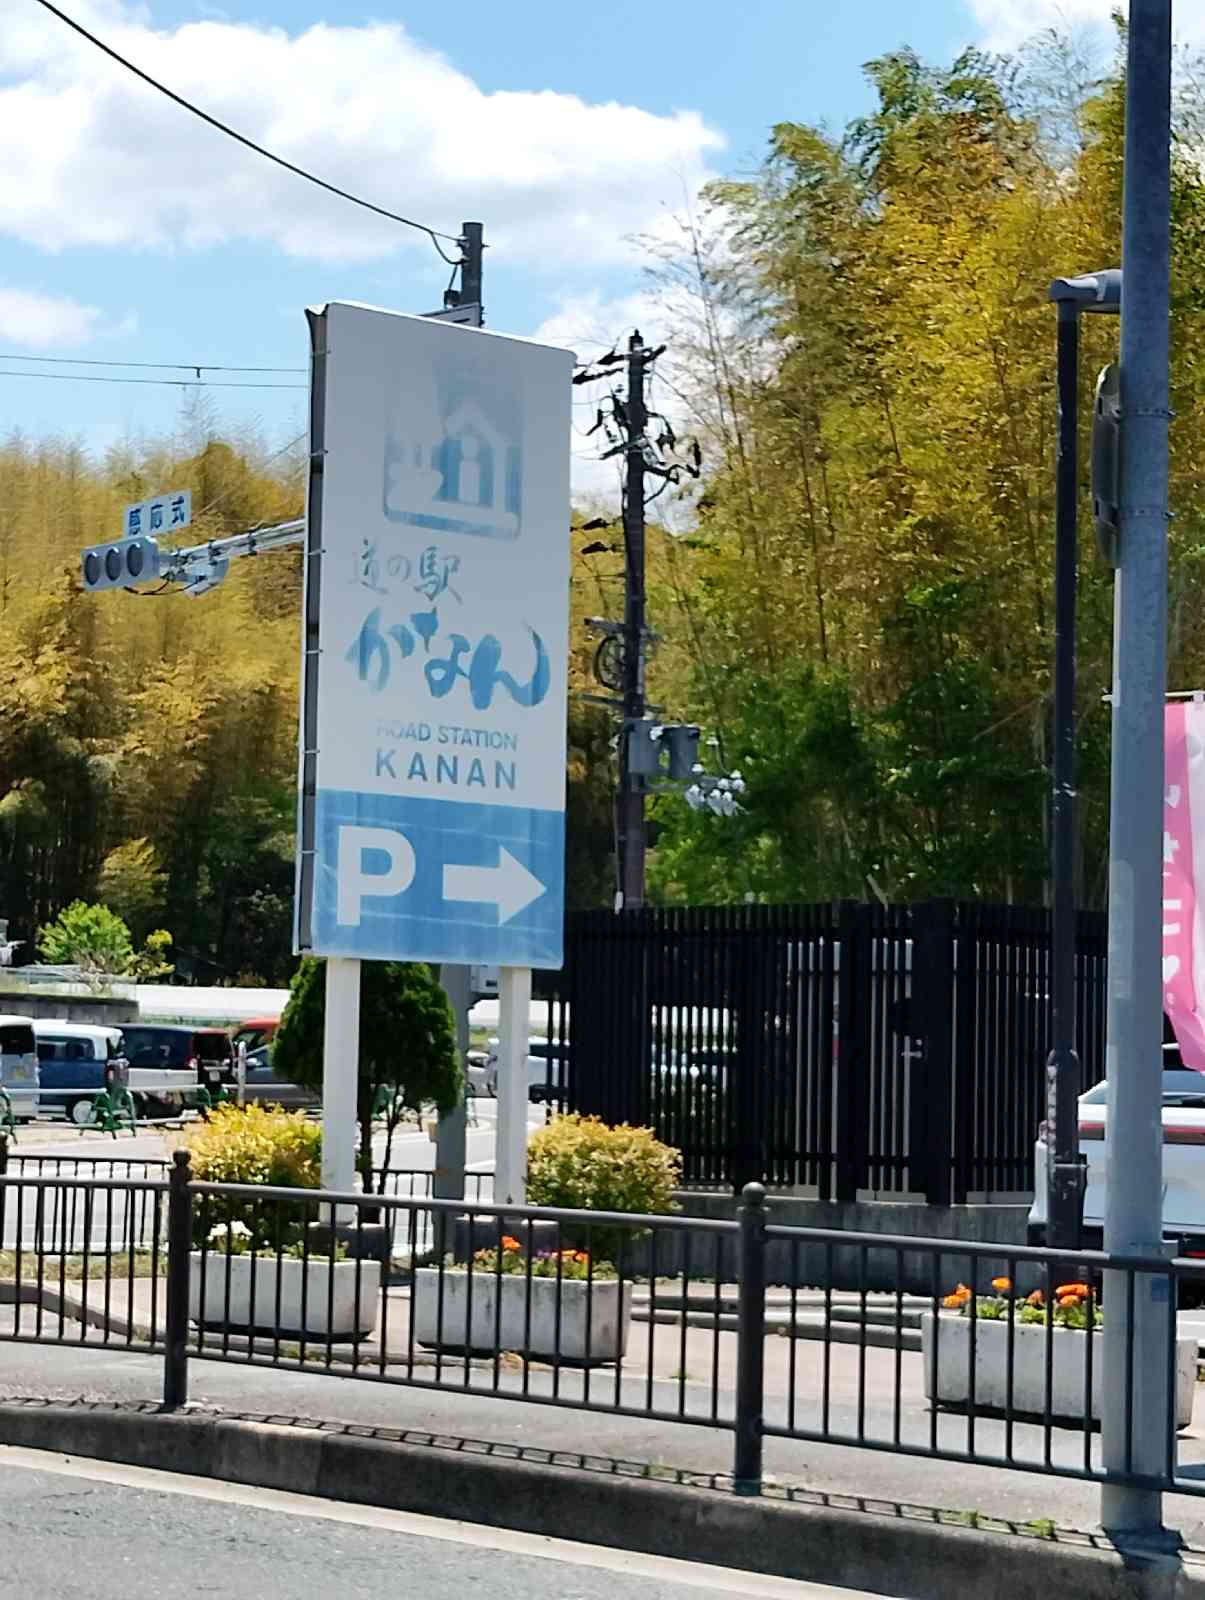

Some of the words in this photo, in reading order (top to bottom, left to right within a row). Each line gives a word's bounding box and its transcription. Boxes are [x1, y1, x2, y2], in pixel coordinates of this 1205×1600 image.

[345, 538, 463, 605] 道の駅
[344, 606, 551, 711] かなん
[375, 747, 517, 790] KANAN
[437, 725, 519, 751] STATION
[337, 825, 416, 926] P
